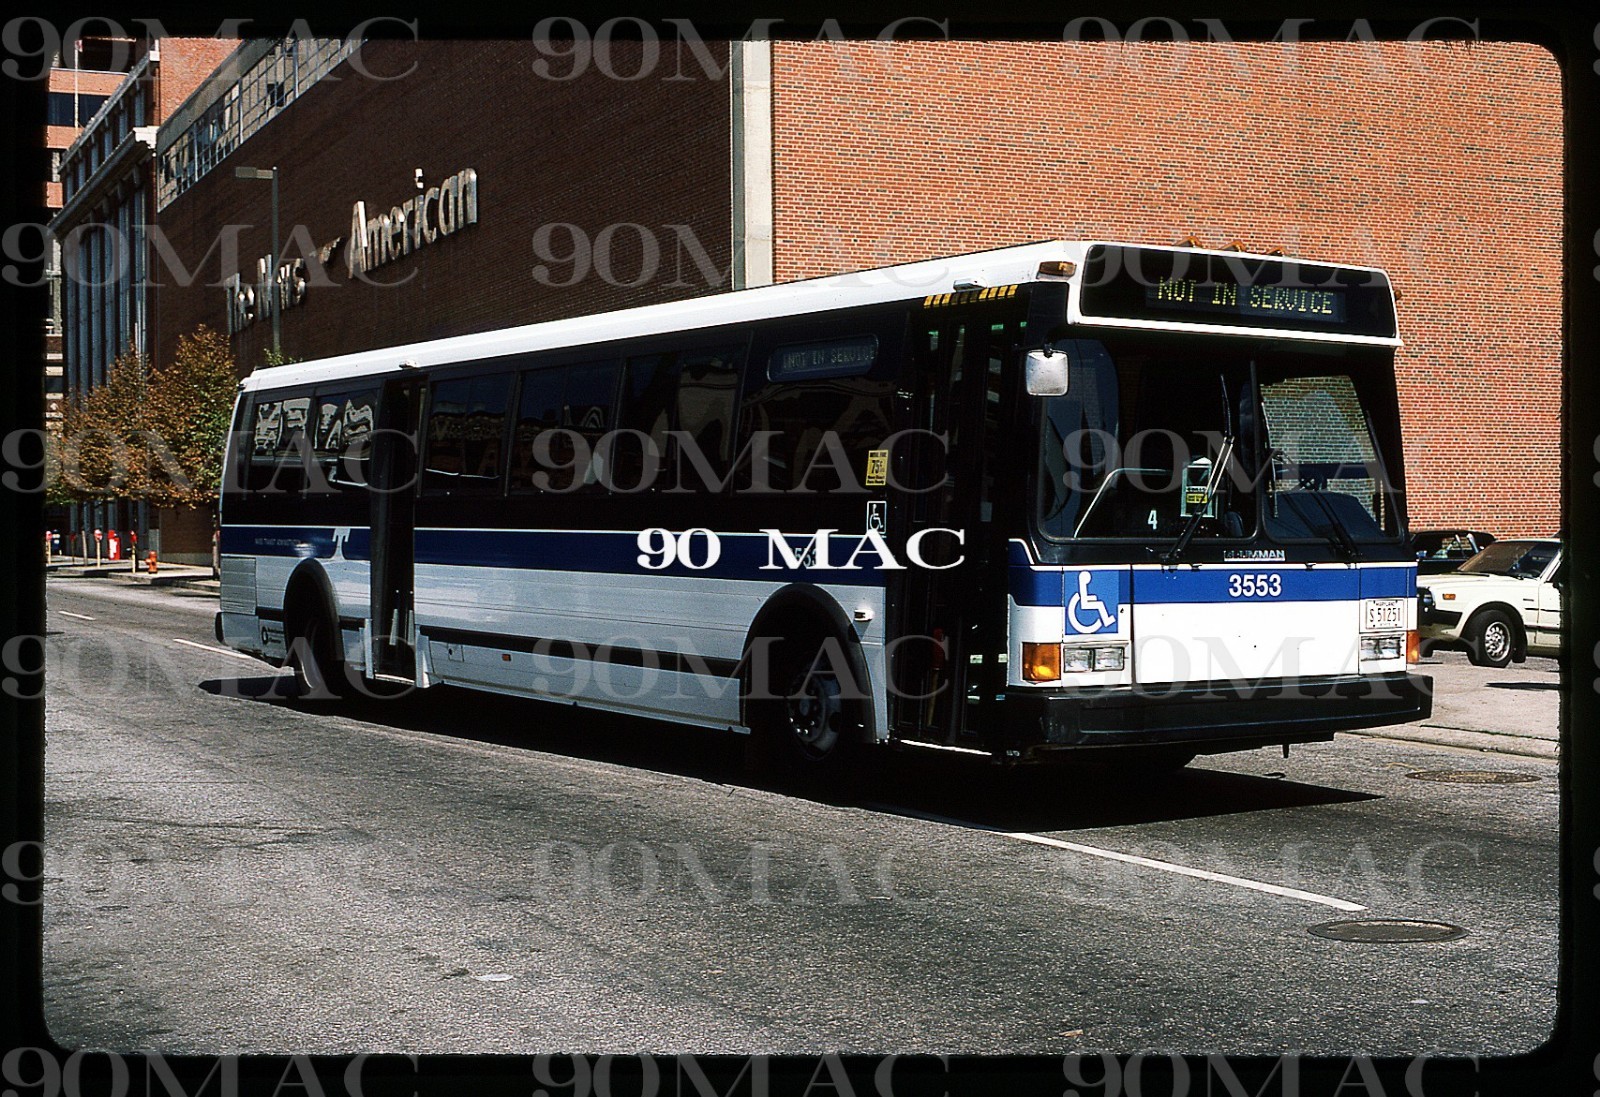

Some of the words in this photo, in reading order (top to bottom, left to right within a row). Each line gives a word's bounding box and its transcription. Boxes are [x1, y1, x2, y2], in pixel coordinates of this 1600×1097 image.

[223, 272, 254, 335] The
[257, 254, 306, 320] Nws
[349, 168, 478, 279] American
[1158, 276, 1197, 302] NOT
[1212, 282, 1237, 306] IN
[1250, 285, 1334, 314] SERVICE
[1147, 509, 1158, 530] 4
[1228, 573, 1282, 598] 3553
[1369, 608, 1375, 623] S
[1377, 607, 1401, 622] 51251
